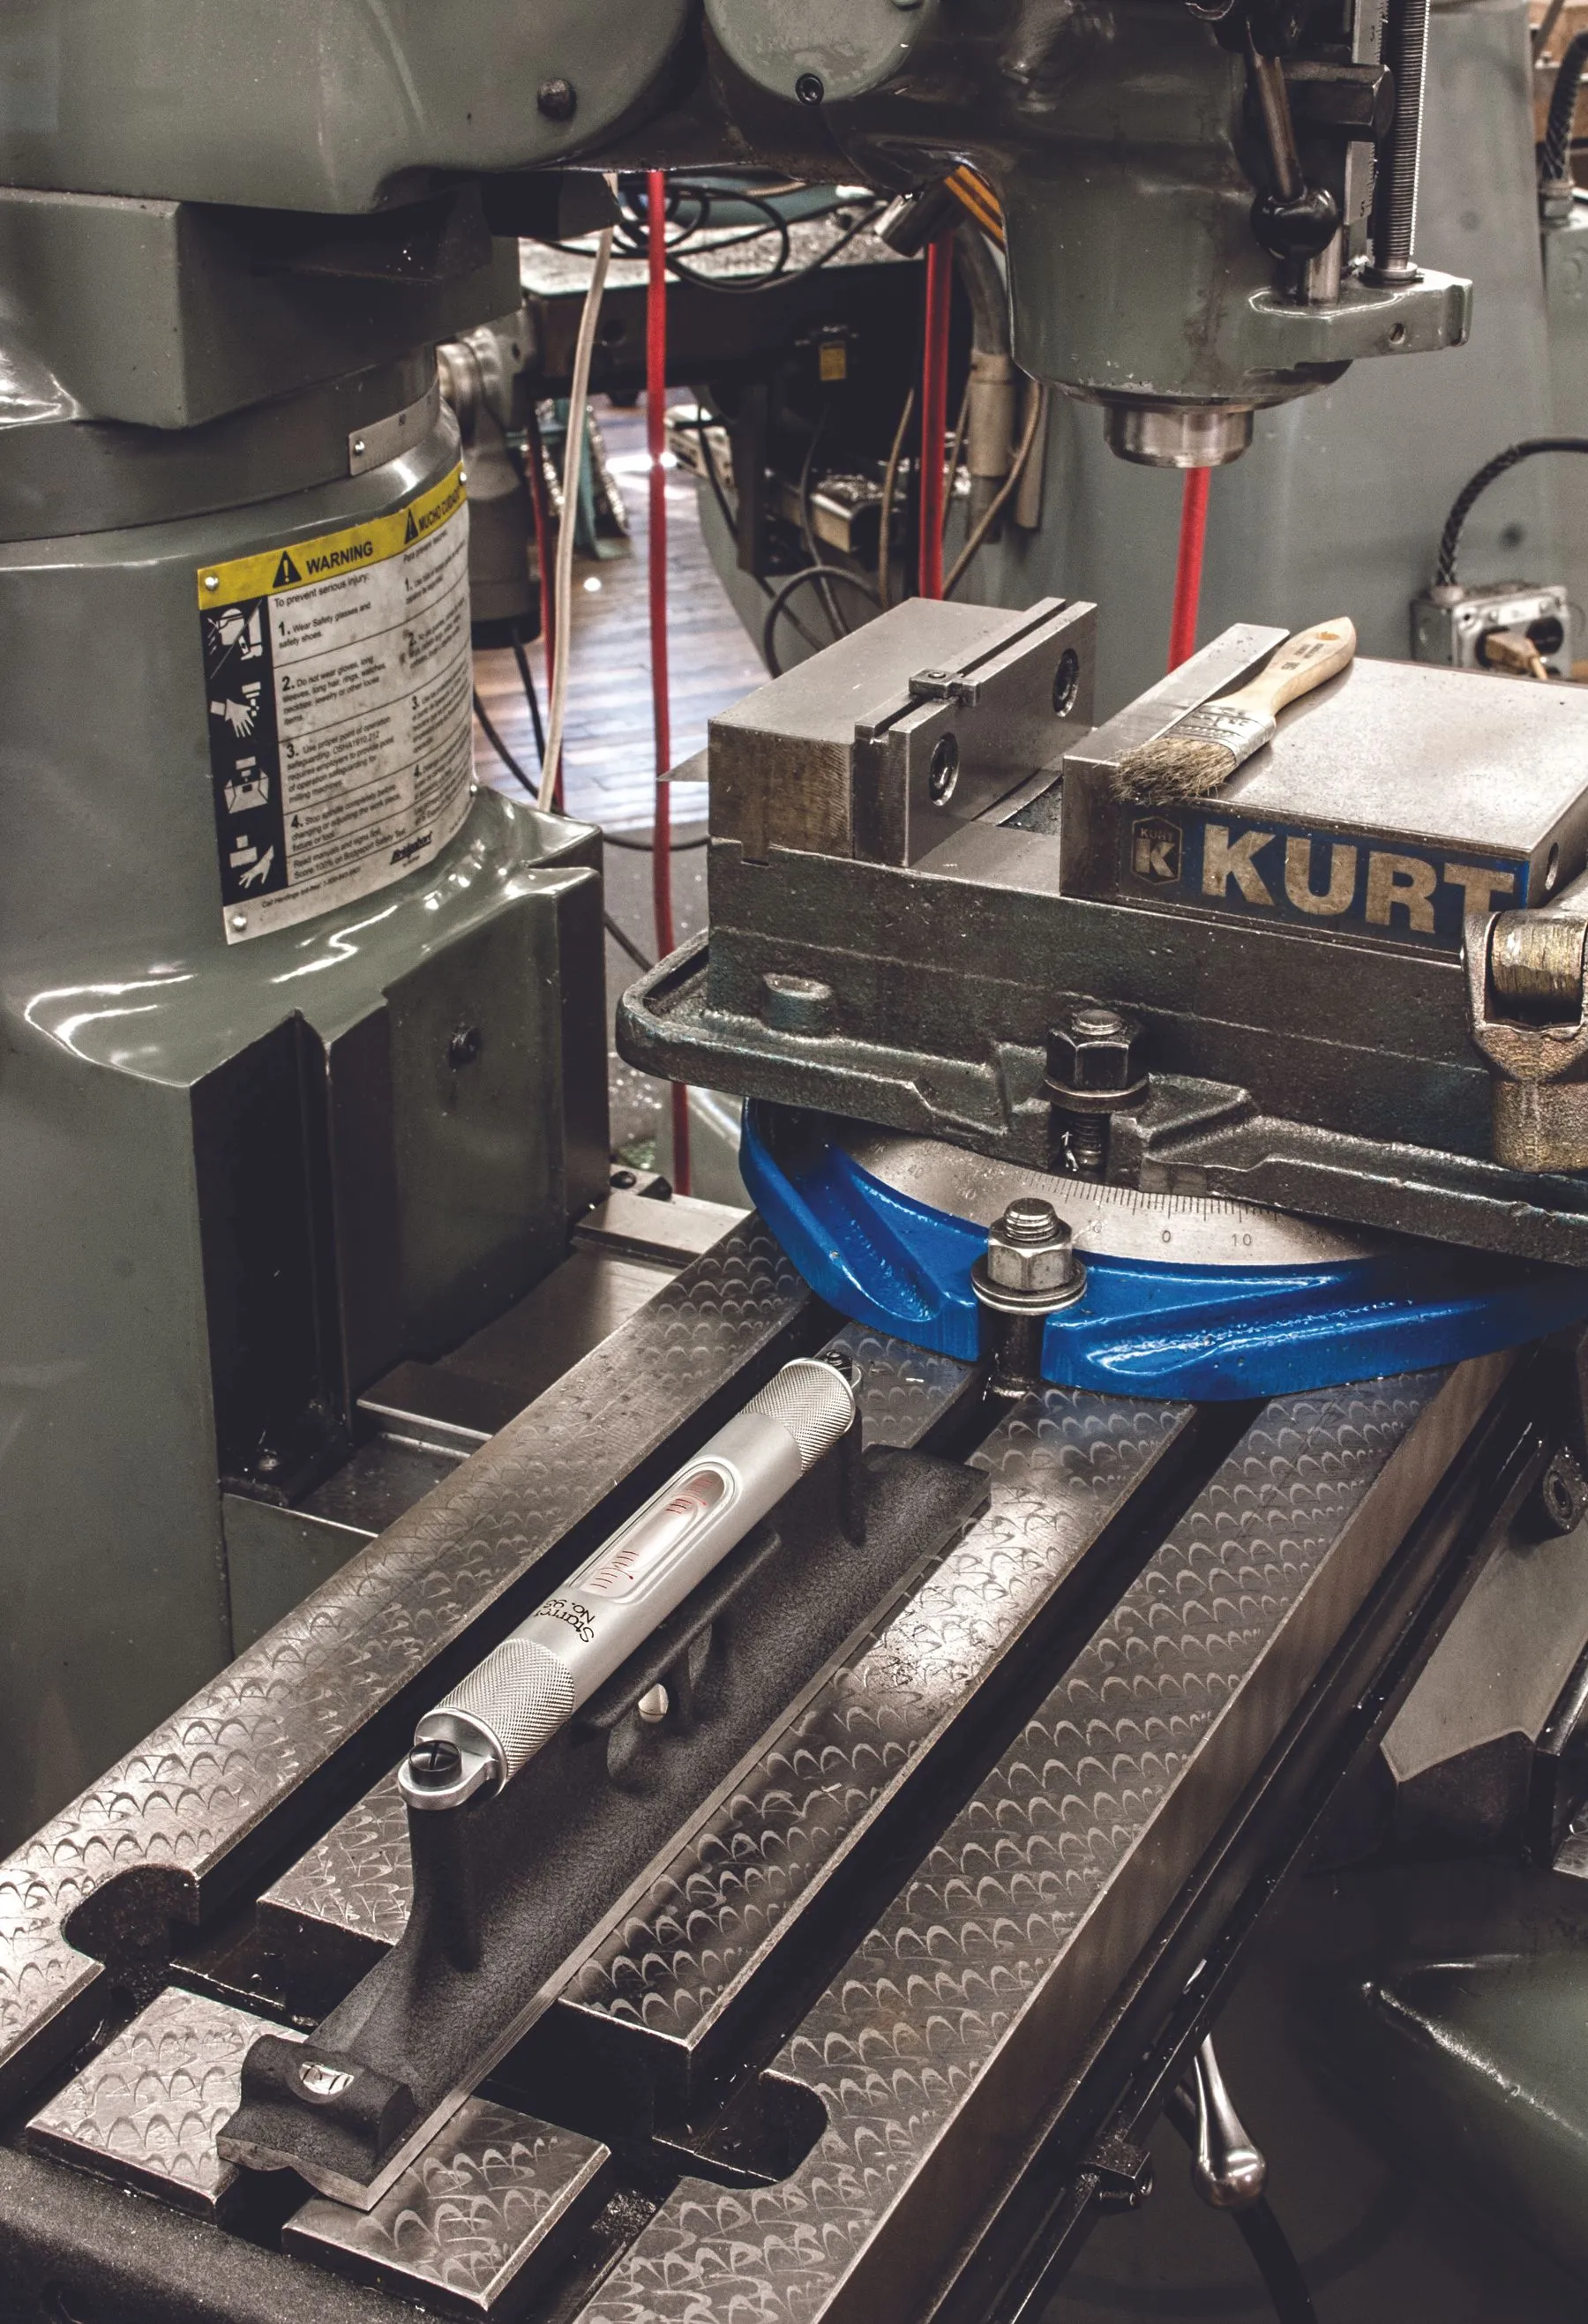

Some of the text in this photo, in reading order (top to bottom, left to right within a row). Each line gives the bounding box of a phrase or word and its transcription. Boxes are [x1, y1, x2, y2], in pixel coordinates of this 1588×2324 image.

[305, 540, 374, 575] WARNING
[274, 573, 370, 608] To prevent serious injury:
[278, 601, 371, 637] 1. Wear Safety glasses and
[279, 637, 300, 648] safety
[281, 675, 296, 692] 2.
[296, 678, 308, 687] Do
[308, 674, 319, 684] not
[320, 669, 336, 679] wear
[360, 656, 374, 665] long
[311, 684, 327, 694] long
[347, 682, 363, 694] other
[363, 676, 380, 687] loose
[286, 743, 299, 759] 3.
[303, 744, 317, 754] Use
[318, 736, 339, 750] proper
[339, 730, 356, 742] point
[363, 716, 392, 731] operation
[288, 768, 316, 781] requires
[316, 754, 348, 773] employers
[356, 743, 379, 758] provide
[379, 736, 394, 749] point
[288, 783, 296, 792] of
[296, 774, 328, 791] operation
[328, 759, 368, 778] safeguarding
[288, 791, 311, 804] milling
[290, 783, 396, 828] 4. Stop spindle completely before
[291, 825, 322, 841] changing
[331, 811, 359, 828] adjusting
[359, 806, 369, 815] the
[370, 799, 384, 811] work
[1141, 828, 1173, 841] KURT
[293, 856, 312, 869] Read
[341, 839, 353, 851] and
[294, 866, 314, 880] Score
[315, 859, 334, 872] 100%
[334, 856, 344, 865] on
[374, 834, 394, 847] Safety
[1135, 837, 1176, 879] K
[1202, 822, 1515, 934] KURT
[1161, 1229, 1172, 1243] 0
[1231, 1233, 1252, 1247] 10
[571, 1601, 596, 1624] No.
